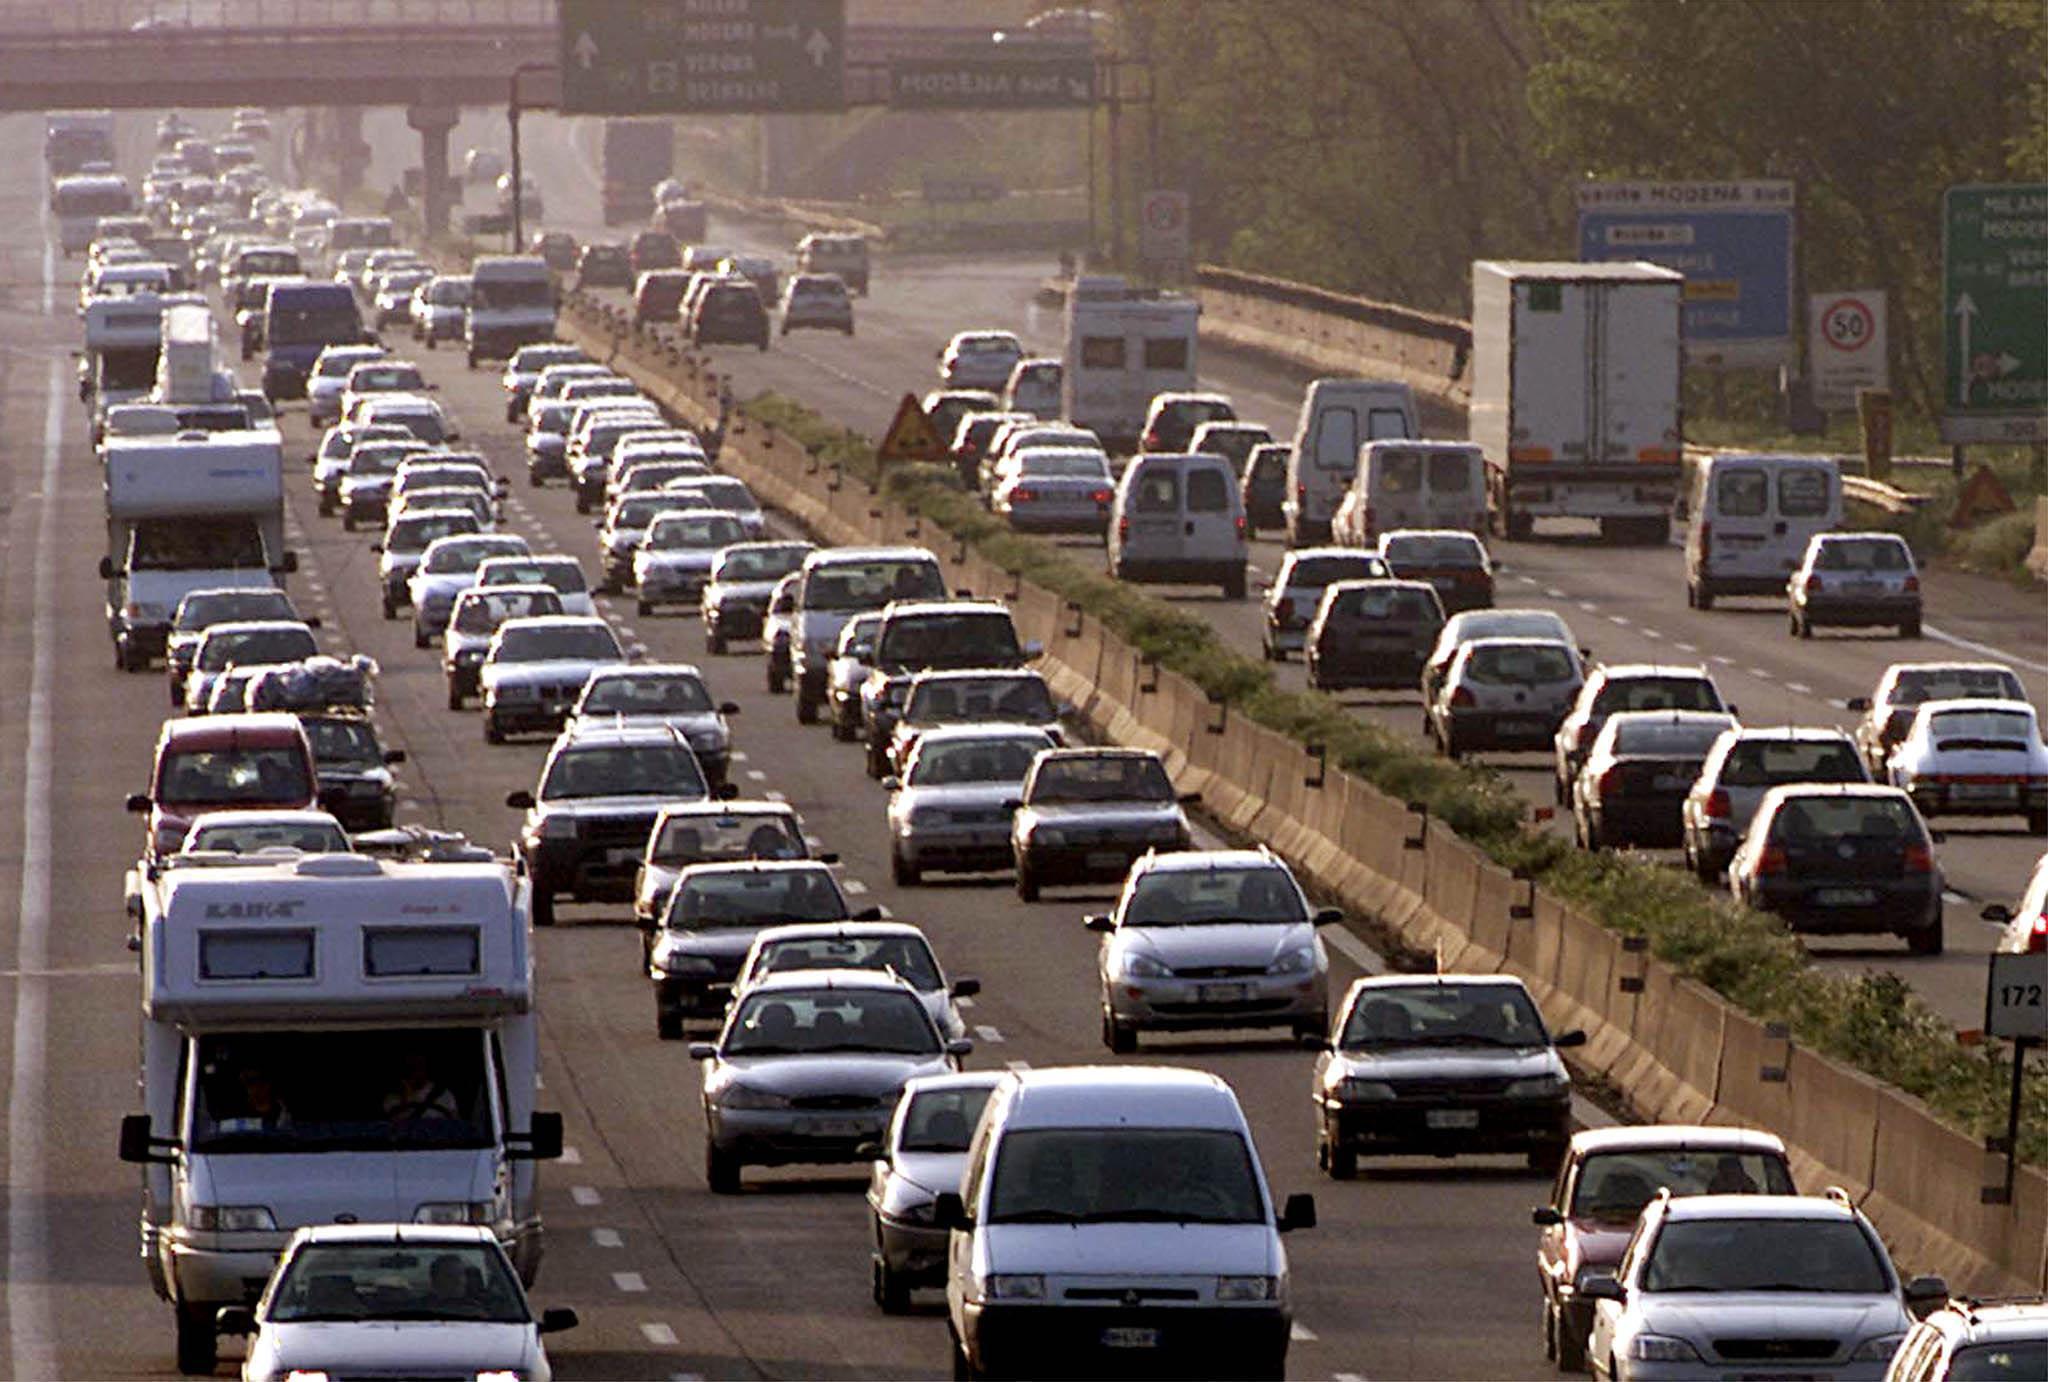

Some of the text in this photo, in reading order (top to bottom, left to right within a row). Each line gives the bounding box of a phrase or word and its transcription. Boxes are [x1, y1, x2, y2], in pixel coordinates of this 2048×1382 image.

[1650, 186, 1743, 204] MODENA
[1833, 312, 1864, 340] 50
[2001, 984, 2042, 1007] 172
